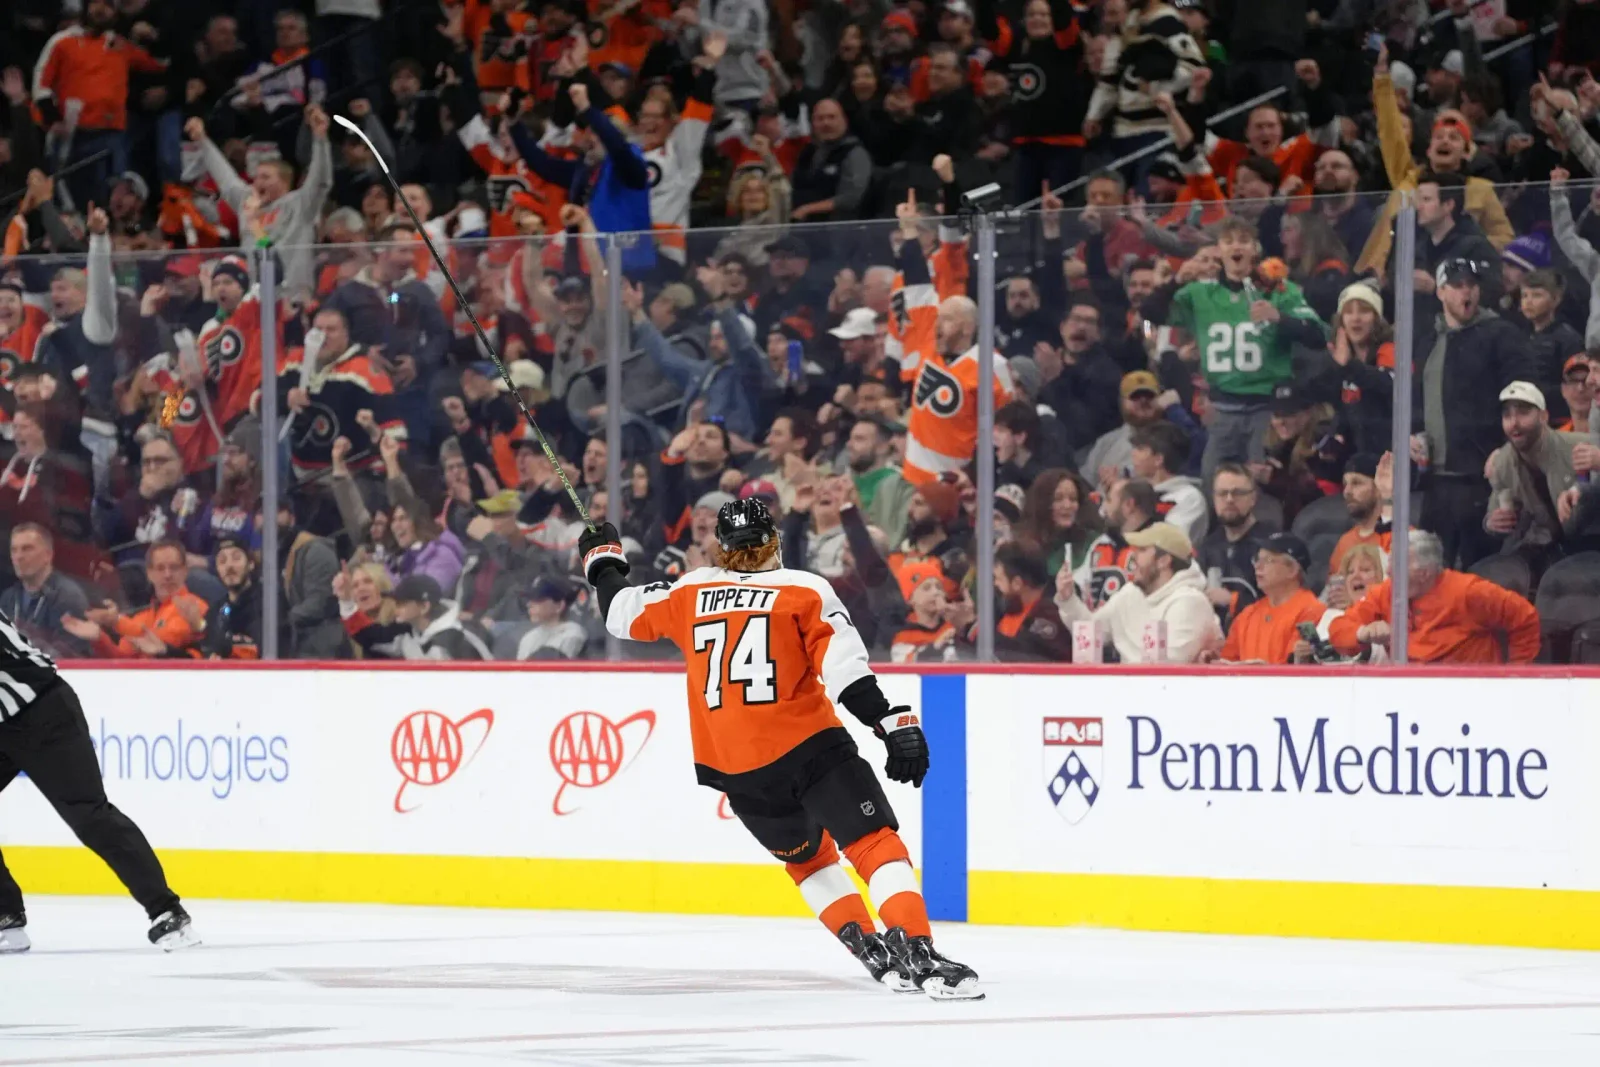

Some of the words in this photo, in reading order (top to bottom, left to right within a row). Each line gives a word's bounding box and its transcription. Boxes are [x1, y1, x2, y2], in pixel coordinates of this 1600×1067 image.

[1206, 321, 1262, 372] 26
[732, 513, 747, 527] 74
[701, 588, 774, 613] TIPPETT
[692, 614, 778, 712] 74
[90, 718, 289, 799] hnologies
[391, 710, 463, 786] AAA
[549, 711, 623, 788] AAA
[1126, 715, 1264, 791] Penn
[1271, 711, 1549, 800] Medicine
